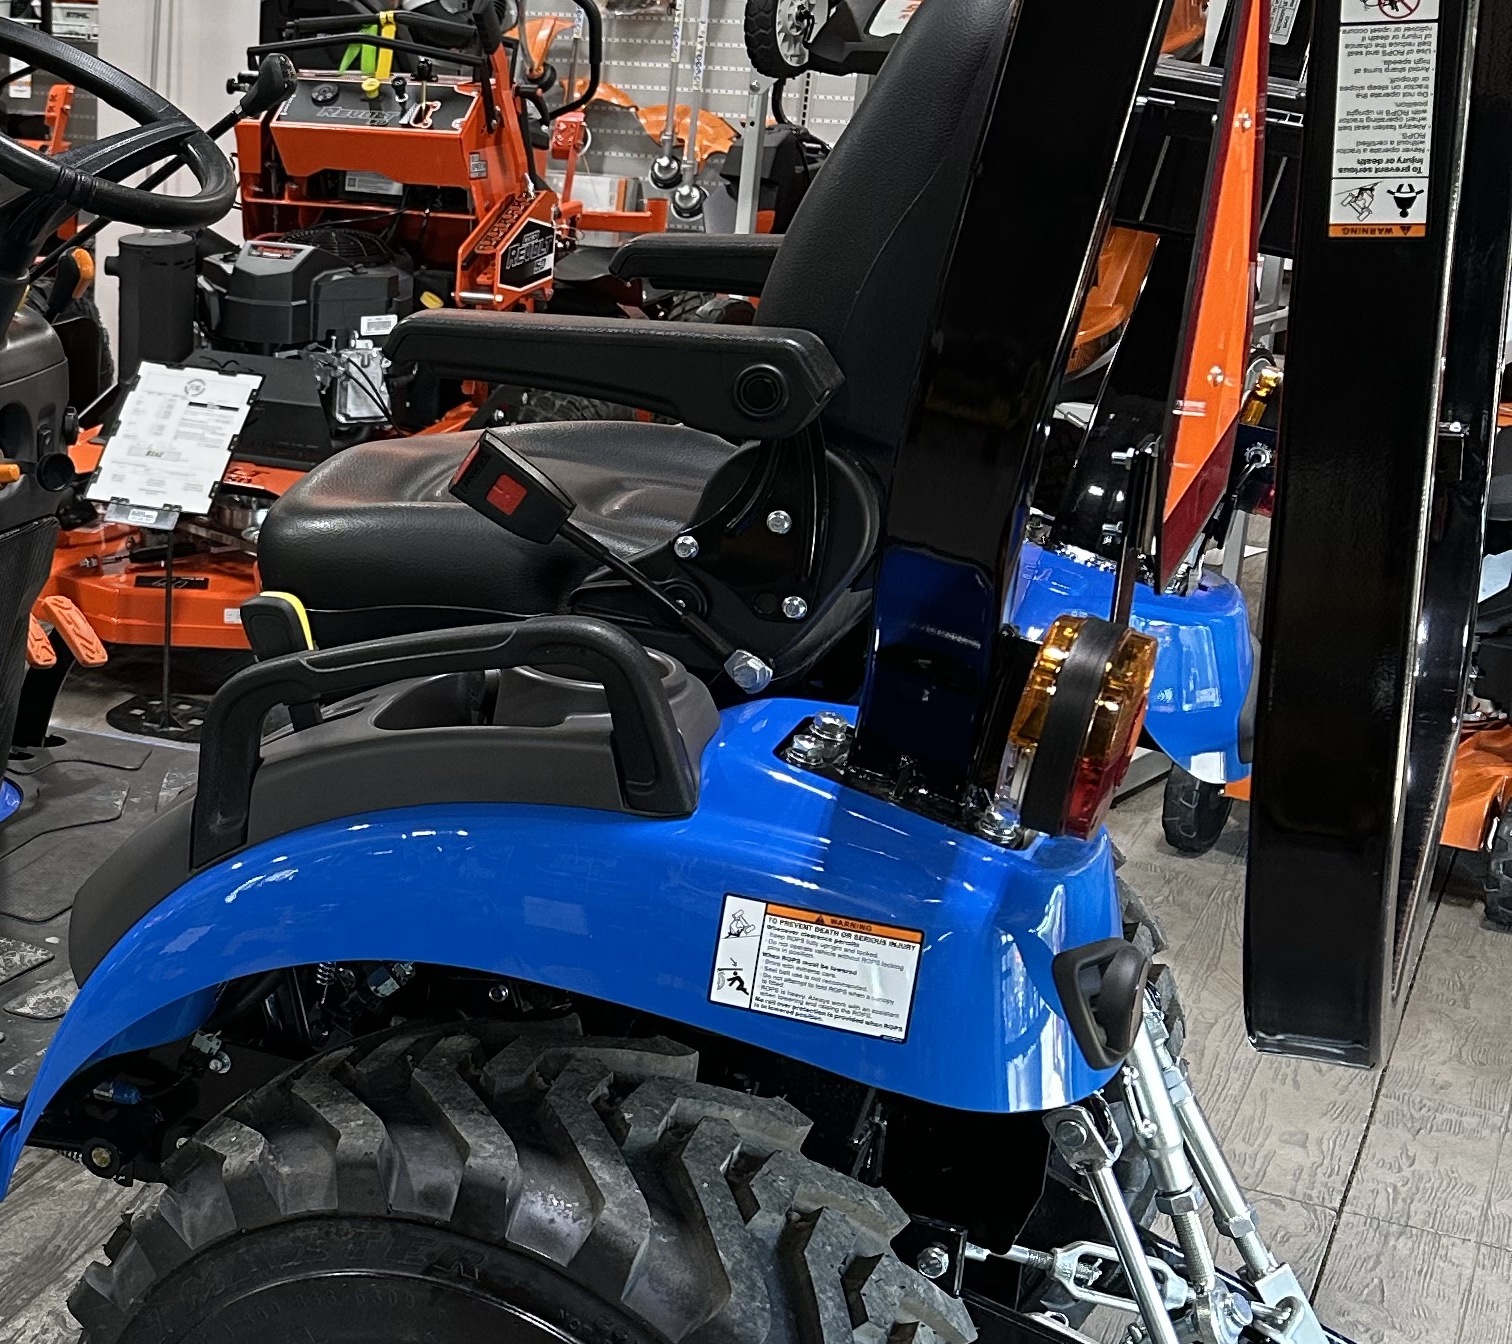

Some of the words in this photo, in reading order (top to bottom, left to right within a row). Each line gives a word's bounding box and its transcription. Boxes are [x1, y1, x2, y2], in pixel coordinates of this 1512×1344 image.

[1374, 165, 1410, 173] prevent
[829, 918, 872, 932] WARNING
[779, 919, 813, 931] PREVENT
[814, 926, 839, 936] DEATH
[840, 931, 852, 939] OR
[853, 933, 886, 946] SERIOUS
[888, 940, 916, 952] INJURY
